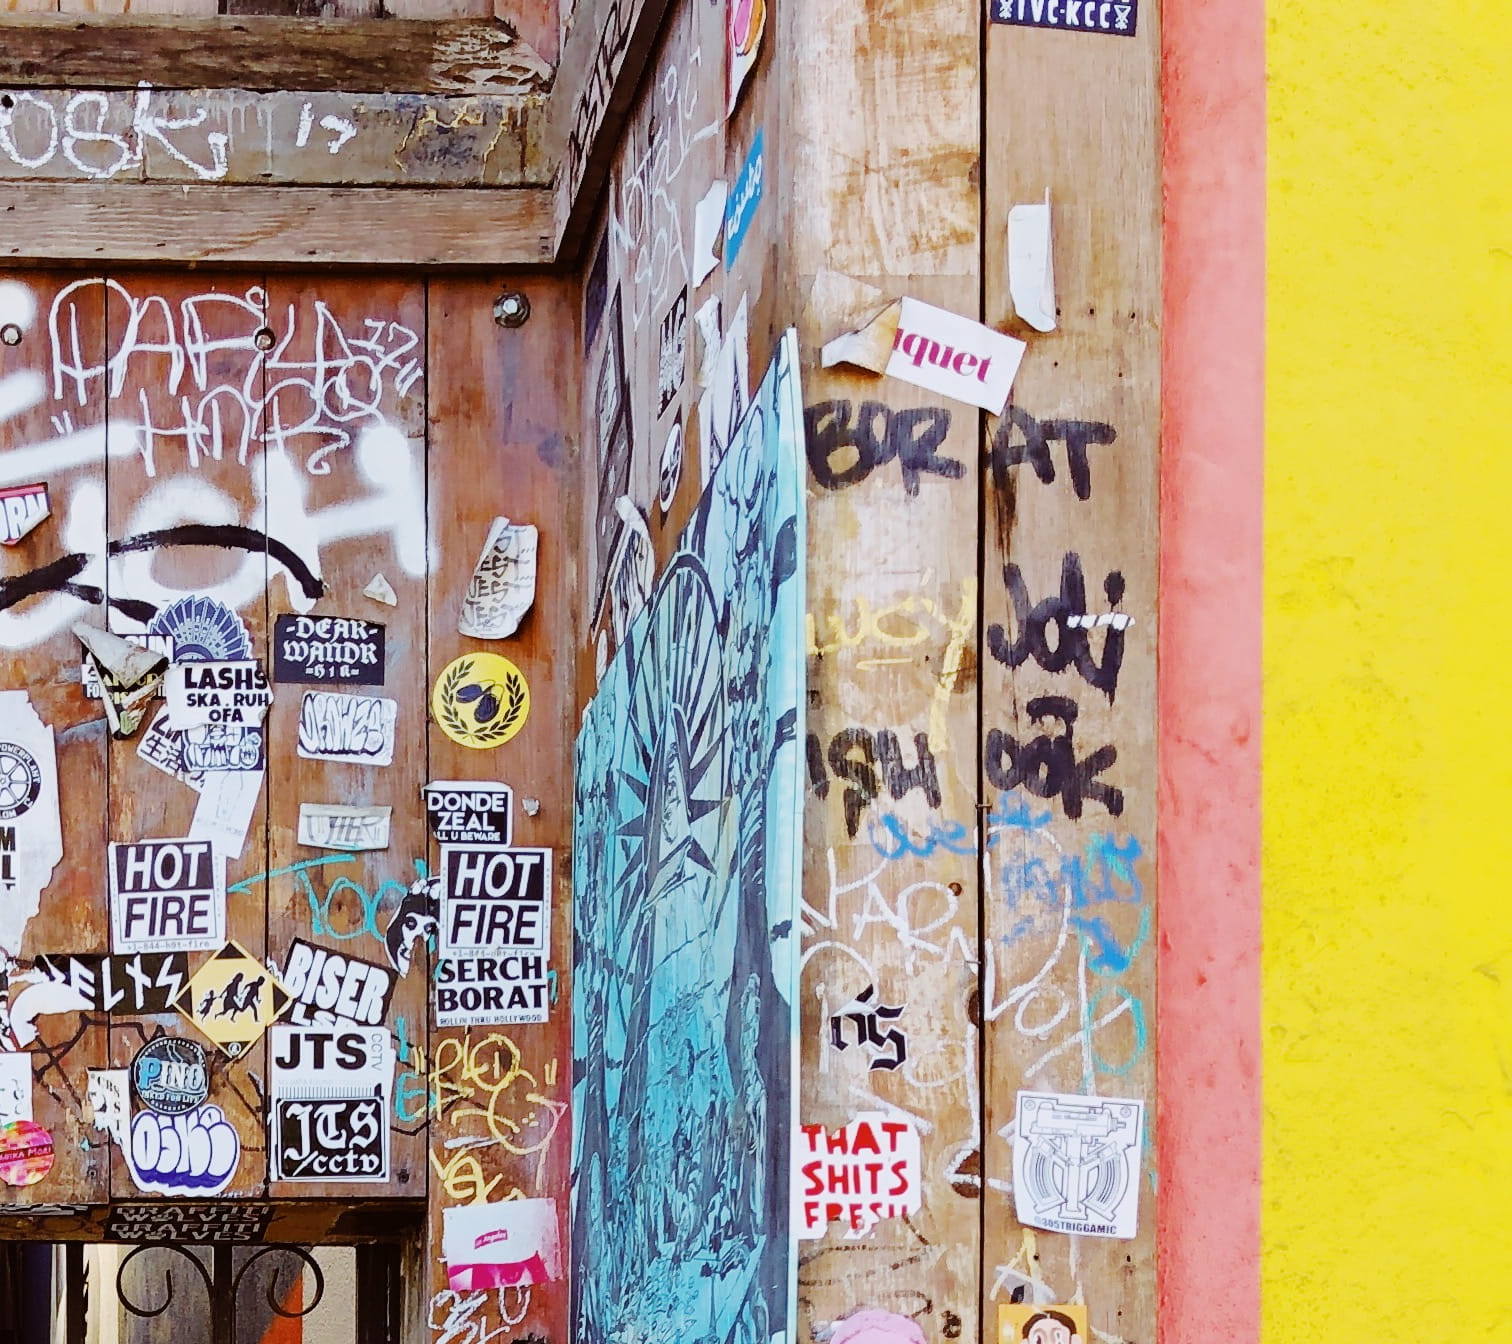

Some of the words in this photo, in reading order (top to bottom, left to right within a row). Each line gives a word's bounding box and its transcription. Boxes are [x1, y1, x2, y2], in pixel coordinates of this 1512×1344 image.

[185, 668, 267, 690] LASHS
[209, 709, 243, 722] OFA
[428, 793, 505, 811] DONDE
[438, 812, 495, 830] ZEAL
[125, 844, 208, 889] HOT
[455, 853, 540, 897] HOT
[125, 896, 212, 939] FIRE
[451, 905, 539, 944] FIRE
[438, 957, 542, 982] SERCH
[289, 956, 388, 1024] BISER
[438, 985, 546, 1011] BORAT
[277, 1033, 367, 1070] JTS
[372, 1034, 383, 1071] CCTV
[139, 1059, 205, 1090] PINO
[801, 1122, 908, 1155] THAT
[802, 1161, 908, 1196] SHITS
